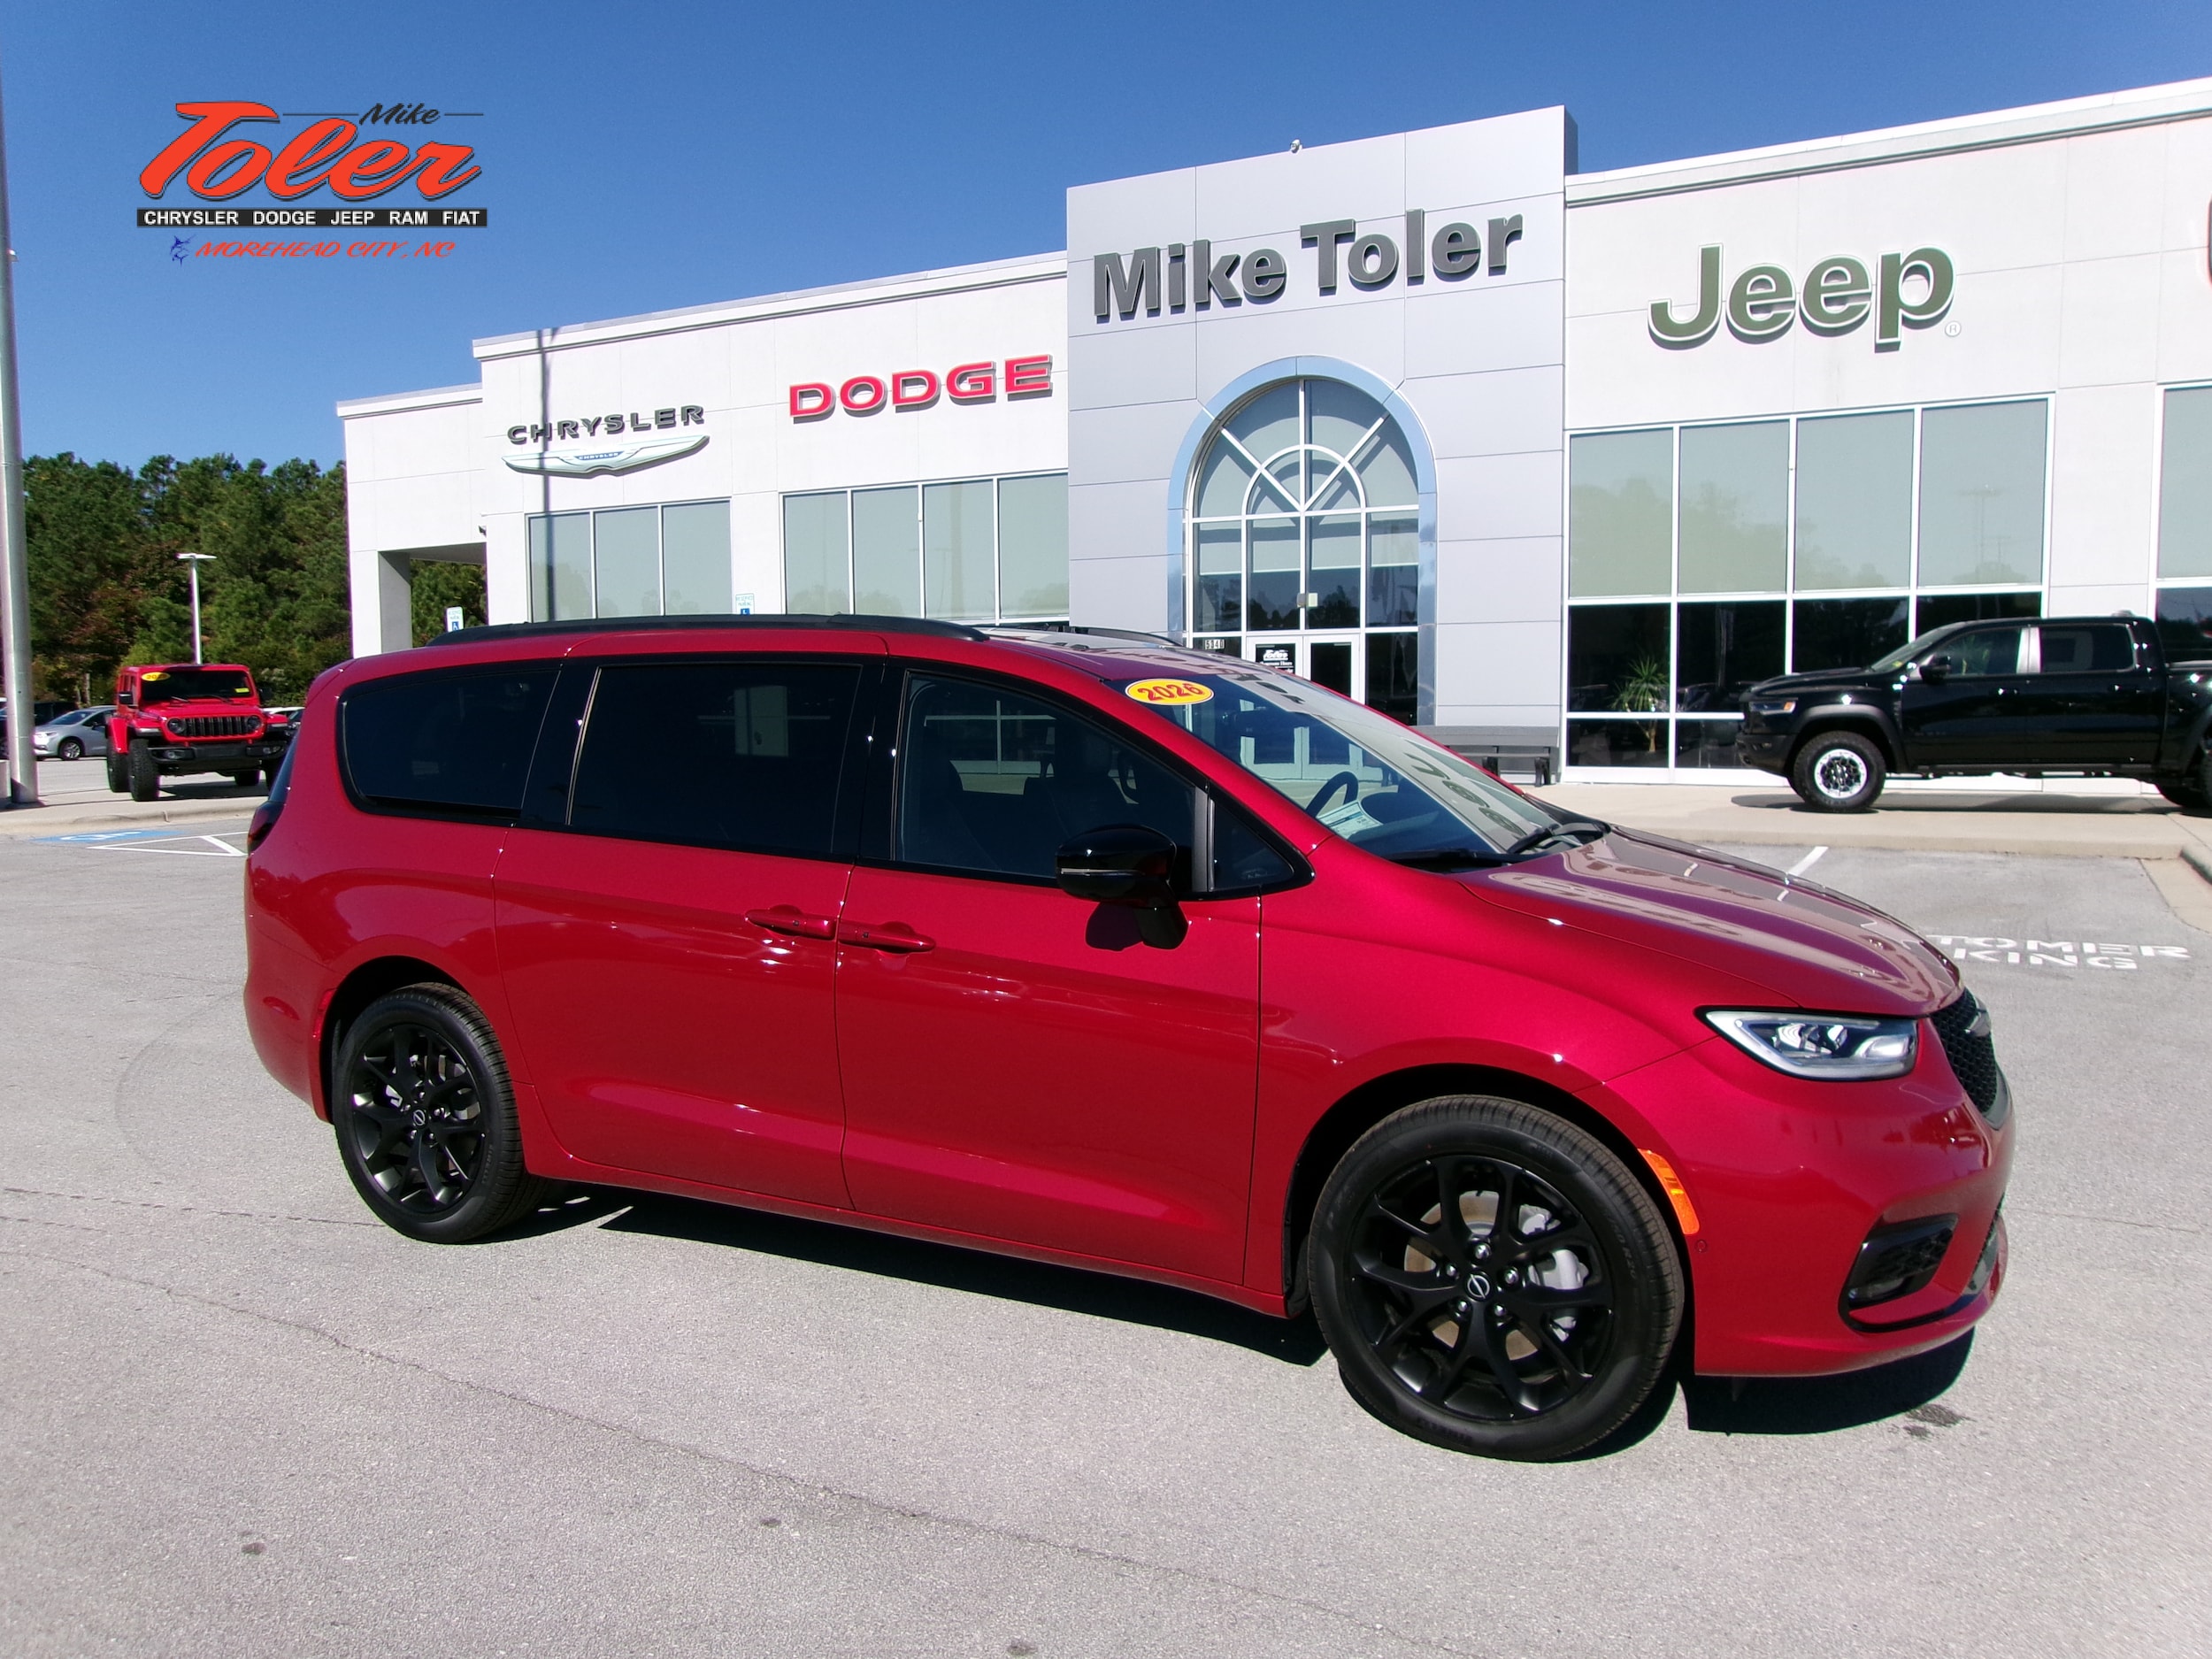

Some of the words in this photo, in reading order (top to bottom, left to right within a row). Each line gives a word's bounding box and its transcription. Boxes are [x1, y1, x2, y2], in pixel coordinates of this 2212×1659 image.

[1094, 238, 1287, 320] Mike
[1300, 208, 1524, 292] Toler
[1647, 242, 1955, 348] Jeep
[789, 354, 1053, 421] DODGE
[507, 404, 704, 443] CHRYSLER
[1137, 683, 1205, 702] 2026
